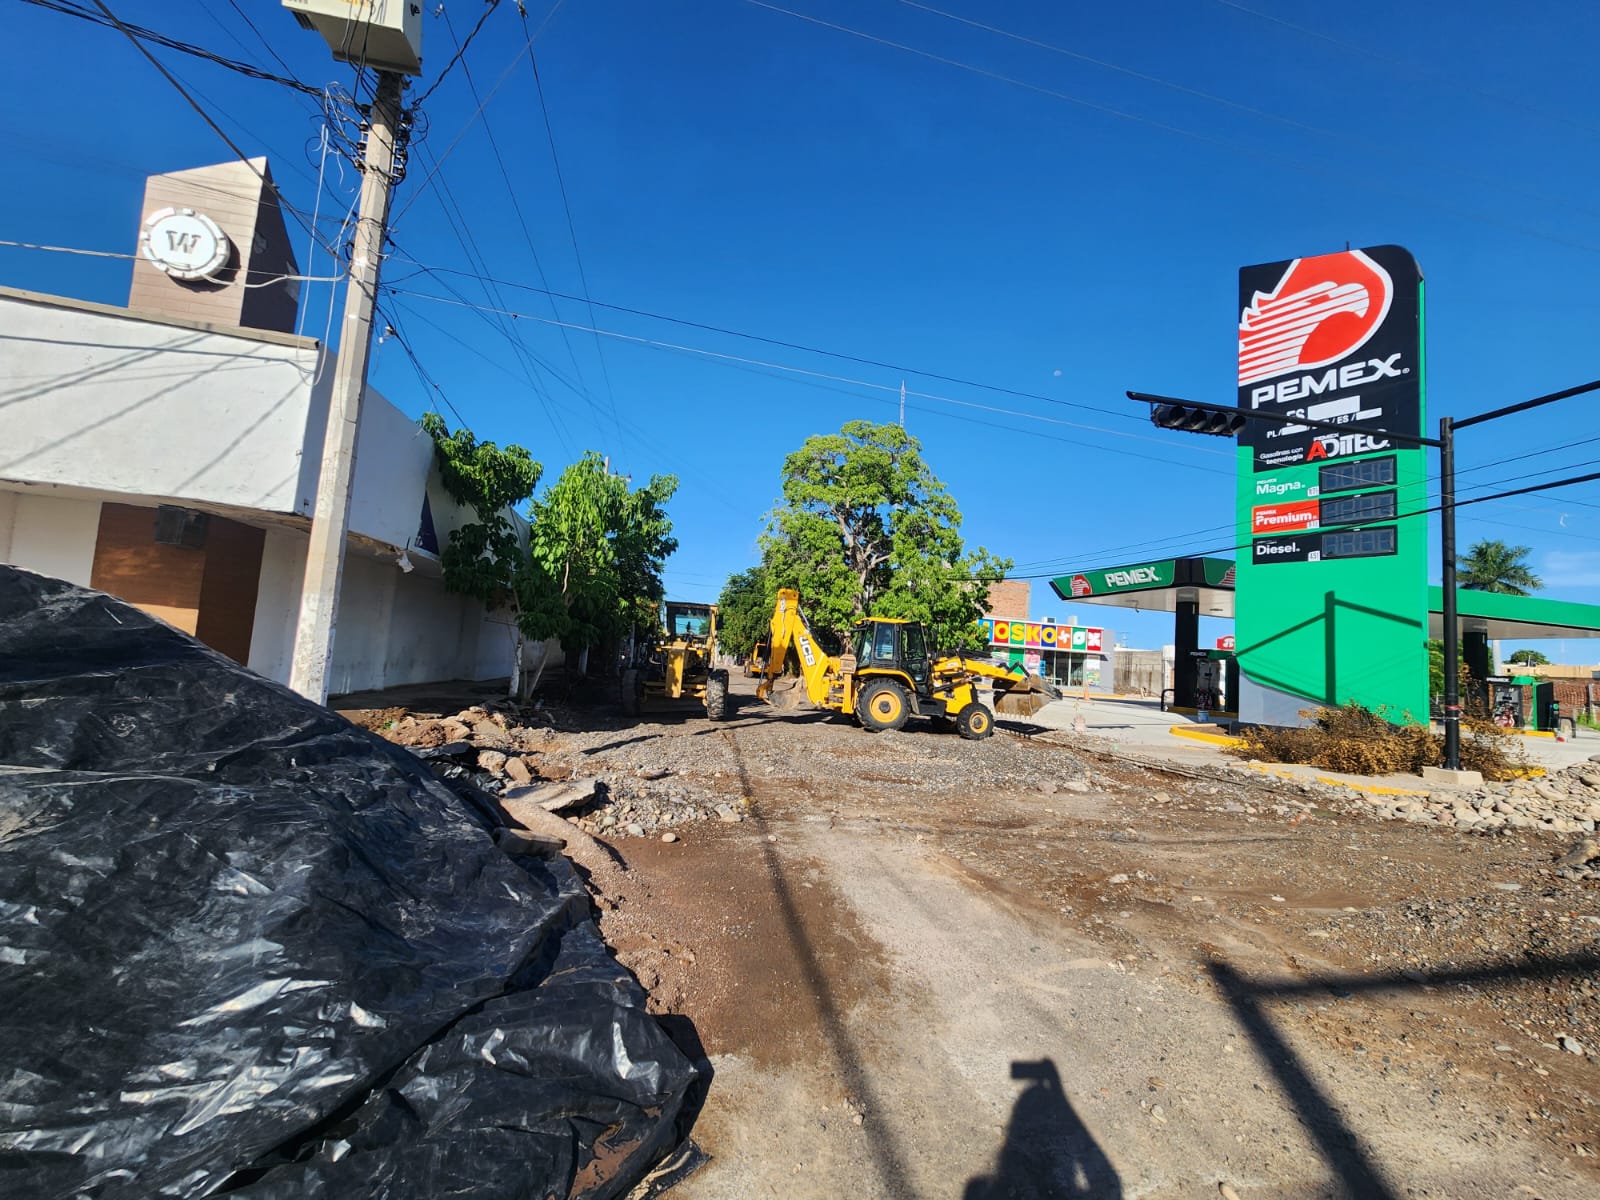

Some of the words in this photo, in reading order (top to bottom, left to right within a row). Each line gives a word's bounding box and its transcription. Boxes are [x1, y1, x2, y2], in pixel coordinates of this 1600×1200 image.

[166, 229, 202, 254] W
[1251, 352, 1402, 410] PEMEX
[1256, 541, 1297, 556] Diesel
[1104, 566, 1158, 588] PEMEX
[799, 636, 816, 666] JCB
